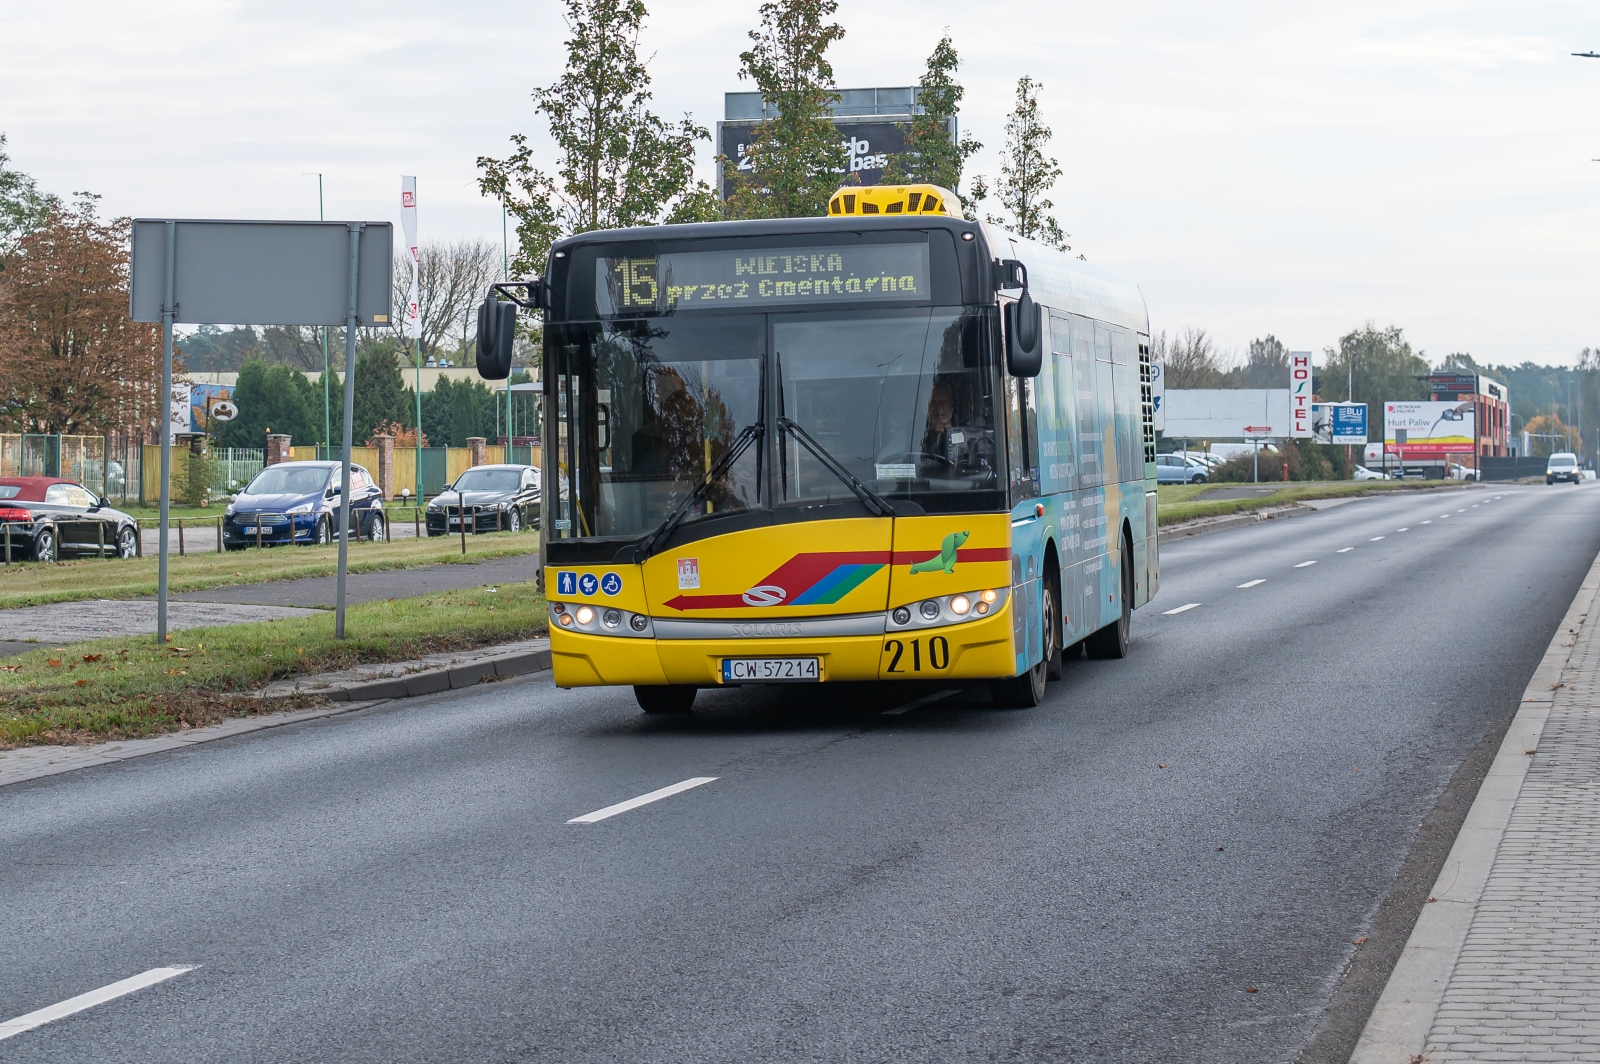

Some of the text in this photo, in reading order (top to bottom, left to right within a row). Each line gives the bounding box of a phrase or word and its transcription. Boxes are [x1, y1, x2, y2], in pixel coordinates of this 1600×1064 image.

[735, 253, 843, 276] WIEJSKA
[615, 258, 658, 306] 15
[1293, 356, 1308, 432] HOSTEL
[1346, 407, 1363, 416] BLU
[1408, 418, 1431, 426] Paliw
[732, 623, 802, 637] SOLARIS
[884, 635, 950, 673] 210
[733, 660, 816, 678] CW 57214
